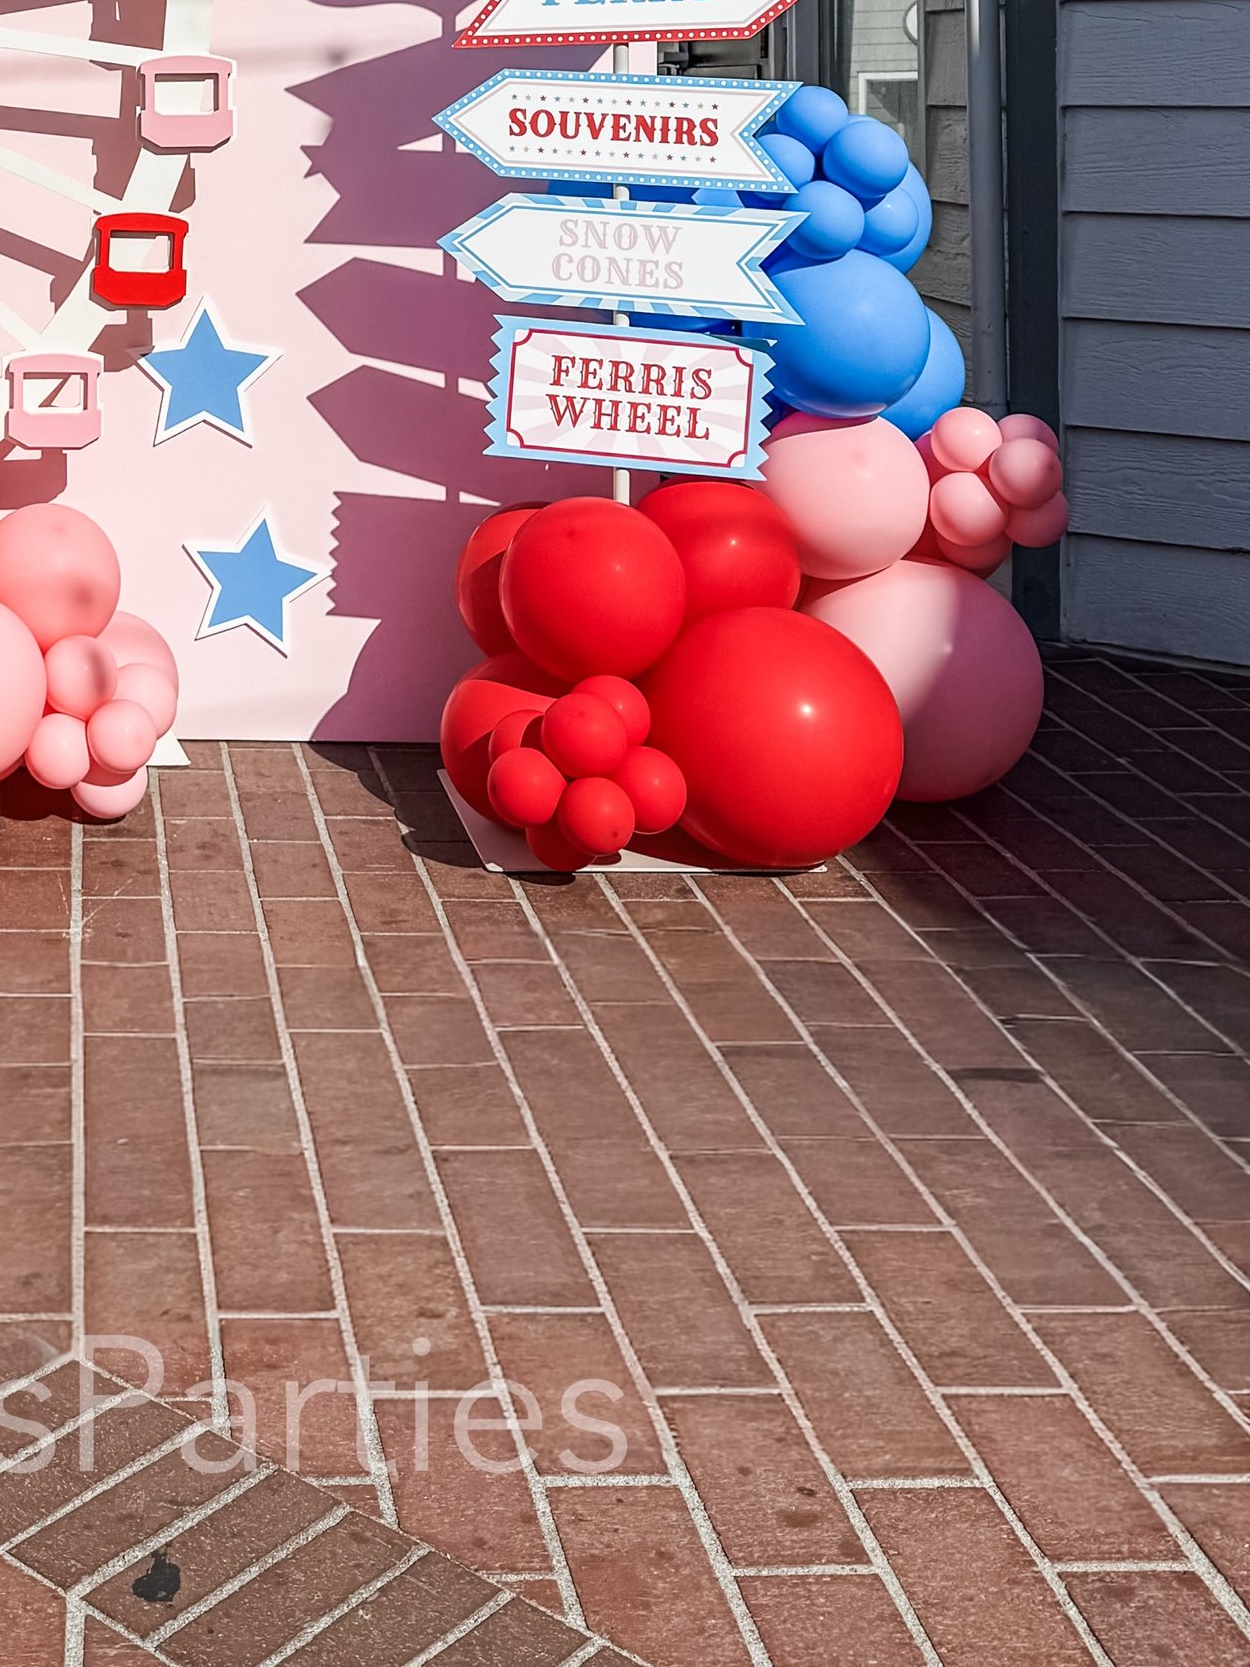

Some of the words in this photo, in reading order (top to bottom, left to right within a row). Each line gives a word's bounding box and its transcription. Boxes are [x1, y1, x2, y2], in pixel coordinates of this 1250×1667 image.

[508, 108, 719, 147] SOUVENIRS
[558, 218, 683, 254] SNOW
[551, 252, 684, 290] CONES
[549, 354, 714, 400] FERRIS
[545, 392, 711, 441] WHEEL
